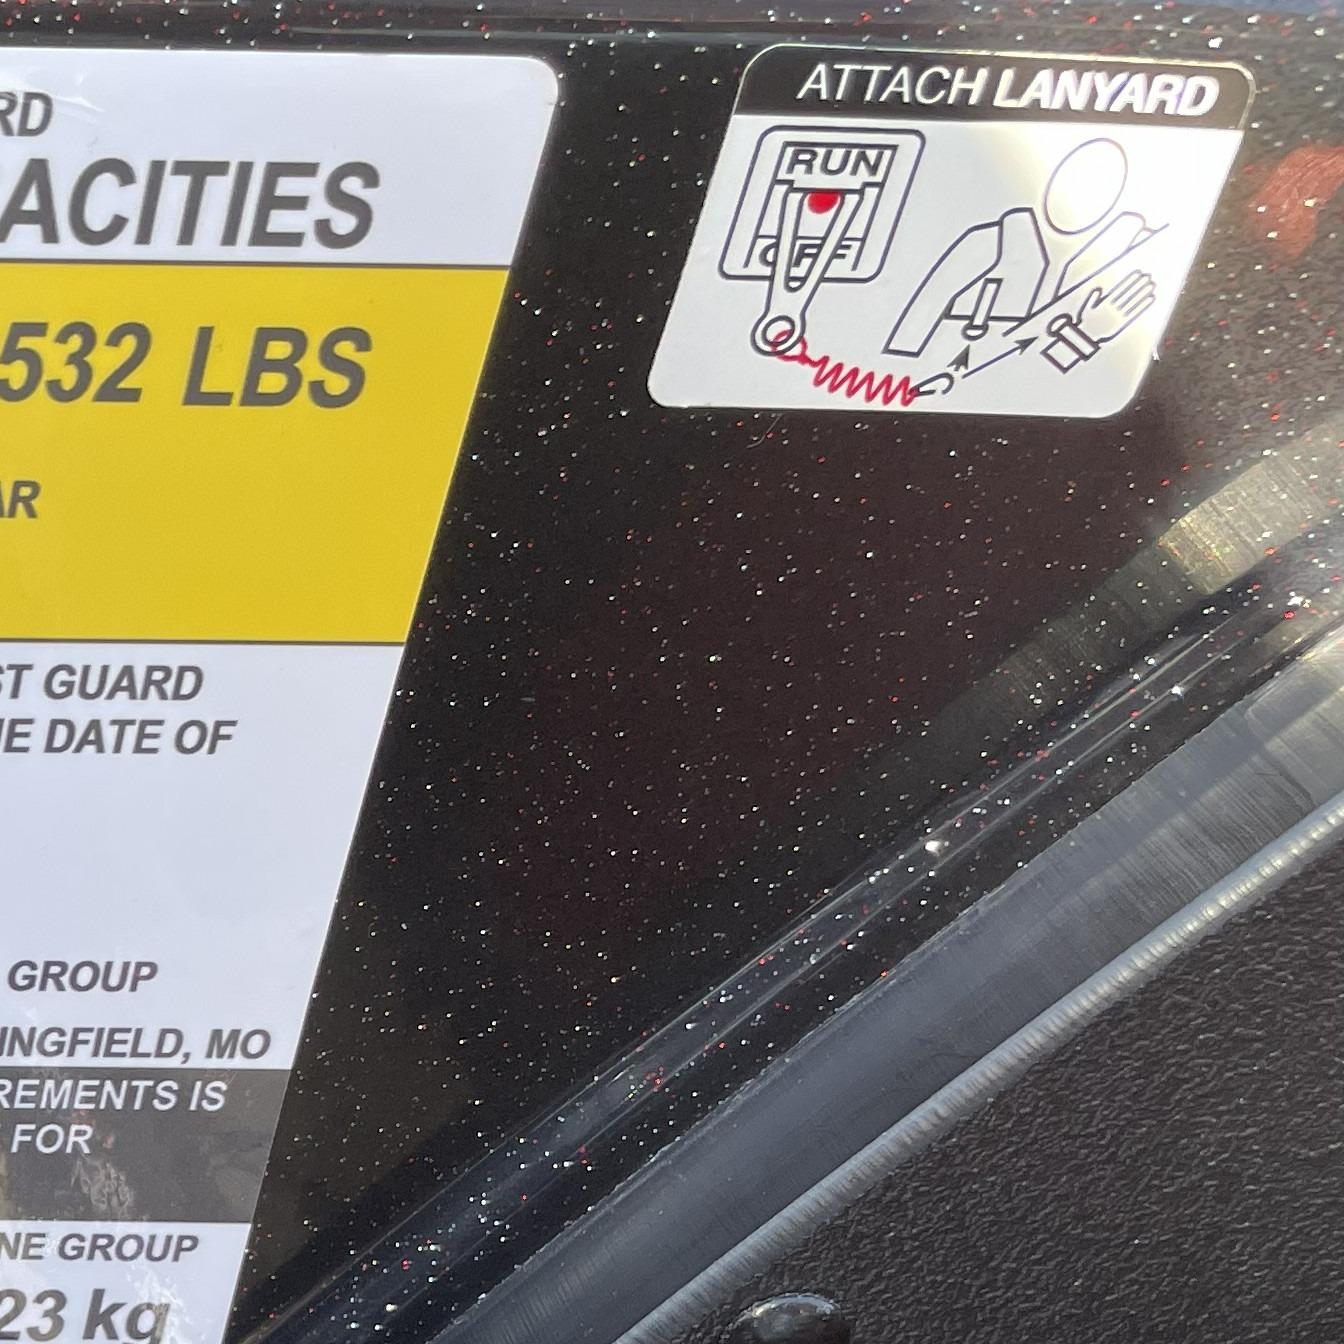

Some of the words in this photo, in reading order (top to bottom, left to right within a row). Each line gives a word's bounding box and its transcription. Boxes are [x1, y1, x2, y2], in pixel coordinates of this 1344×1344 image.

[795, 63, 989, 107] ATTACH
[990, 68, 1220, 116] LANYARD
[784, 148, 886, 177] RUN
[182, 326, 372, 409] LBS
[44, 664, 203, 701] GUARD
[205, 1029, 271, 1059] MO
